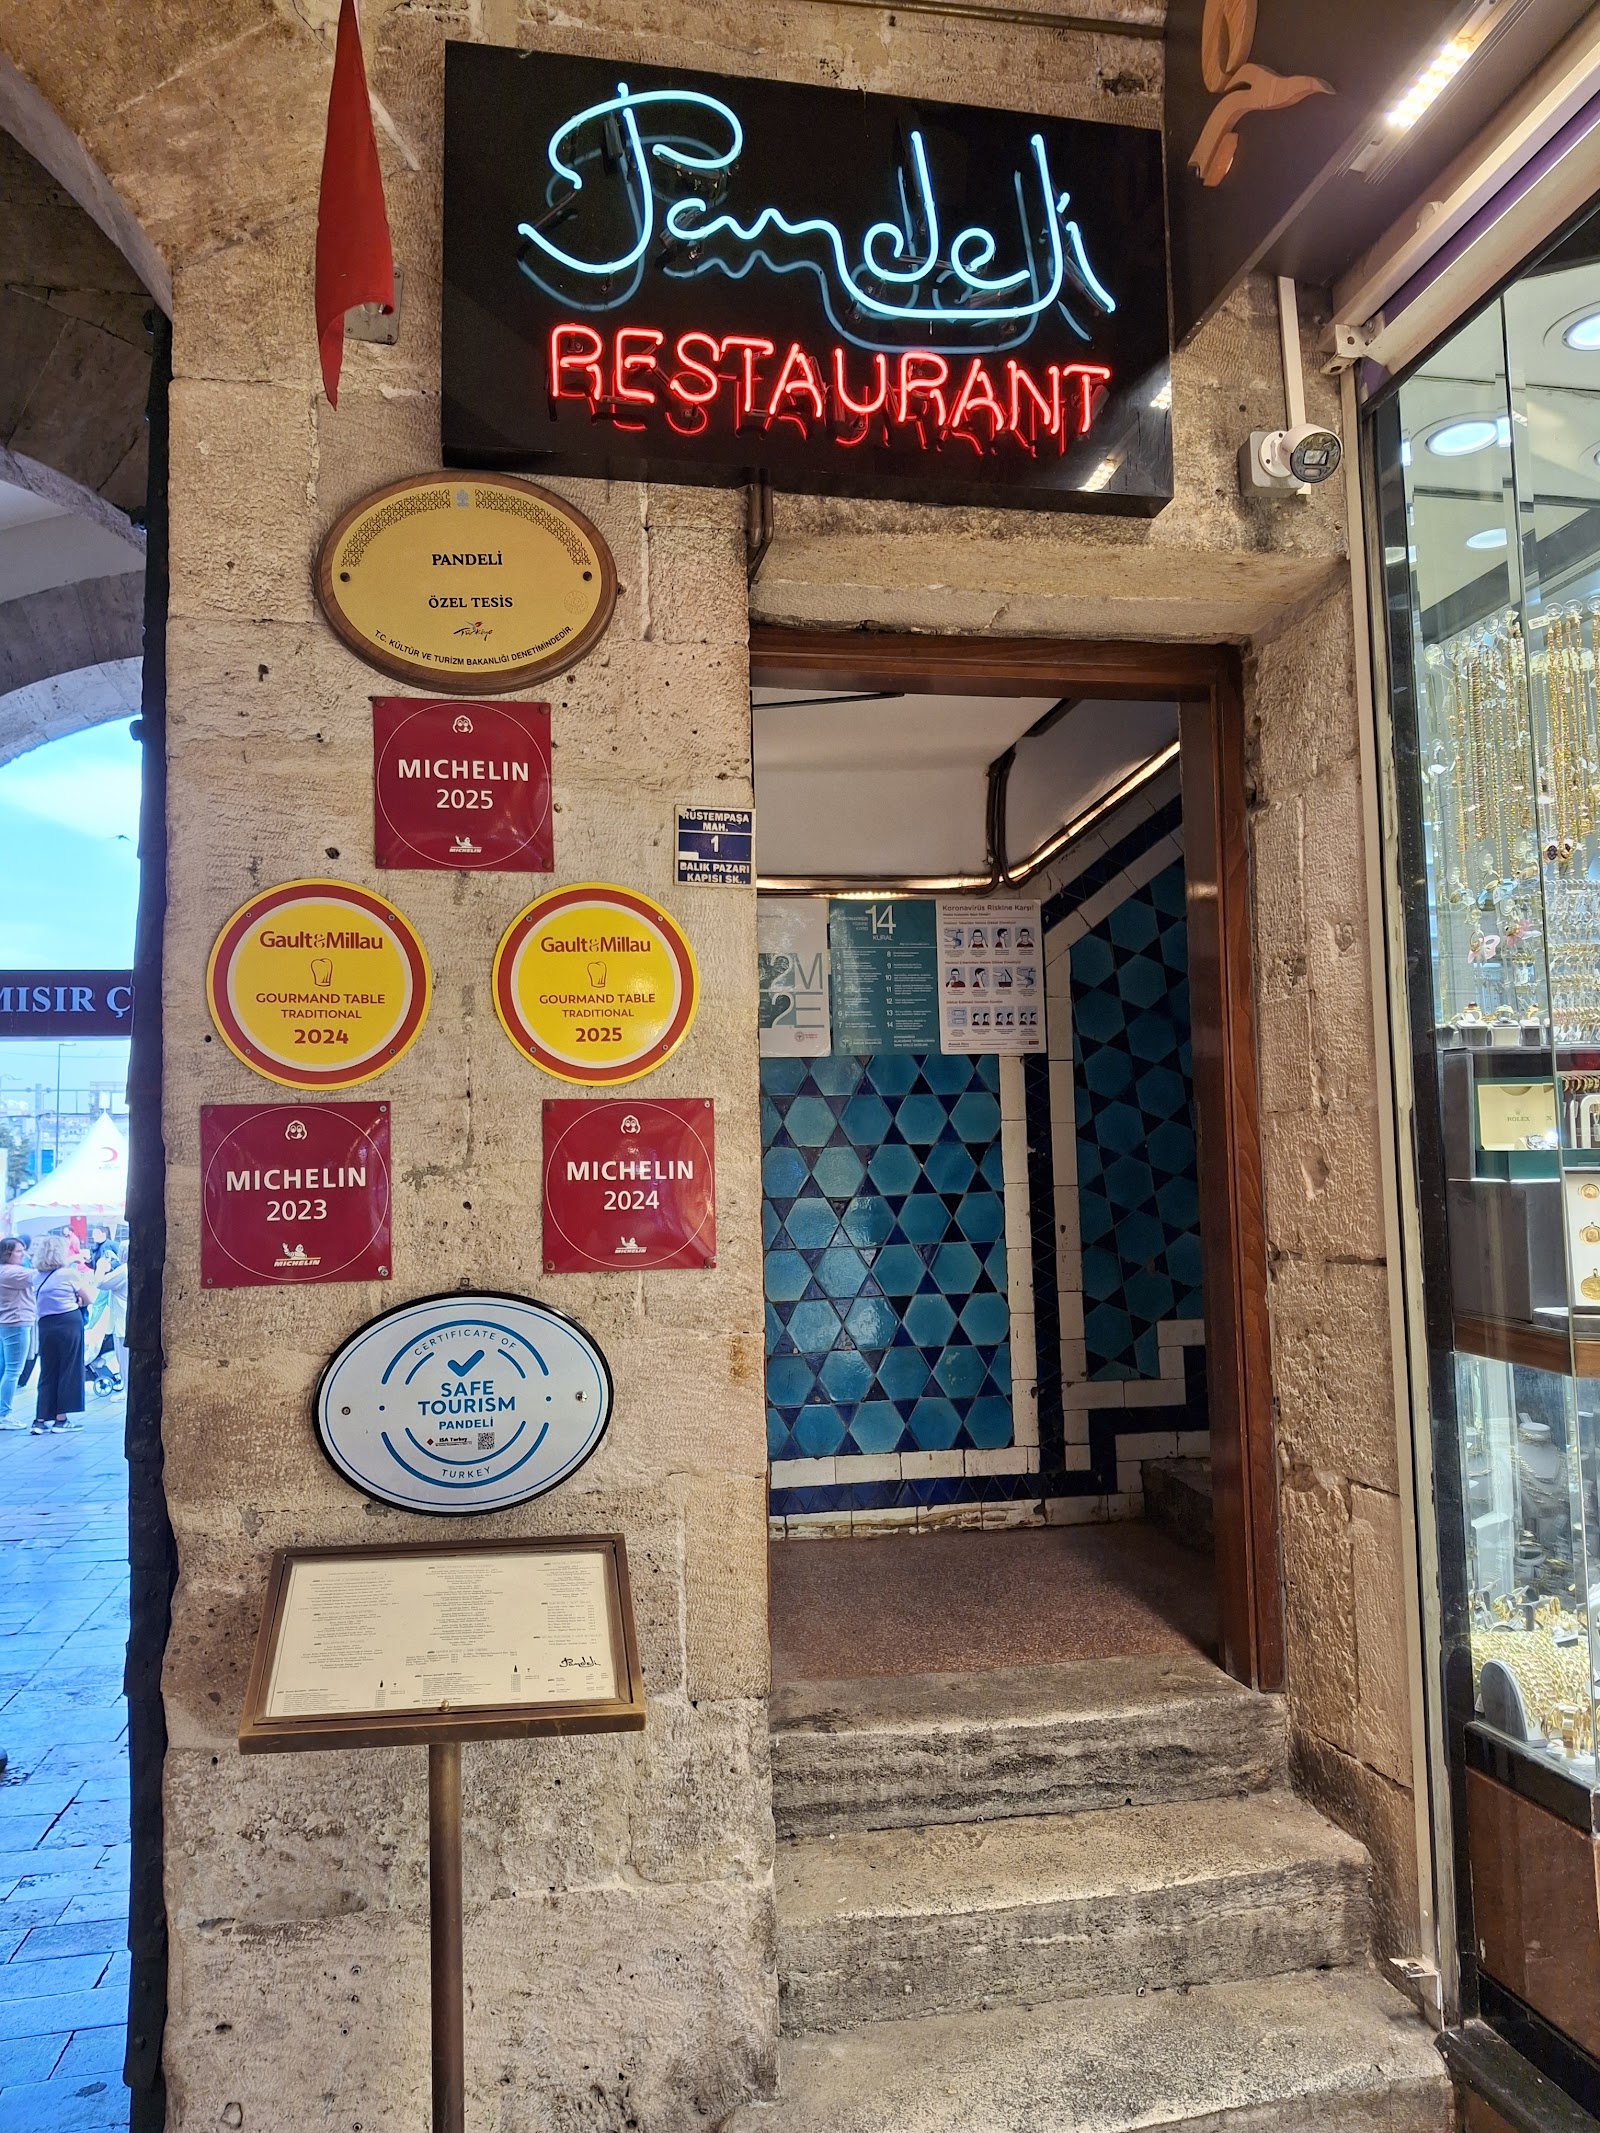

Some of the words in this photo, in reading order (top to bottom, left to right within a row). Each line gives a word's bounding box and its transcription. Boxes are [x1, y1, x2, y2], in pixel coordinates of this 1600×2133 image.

[519, 82, 1116, 319] Pandeli
[550, 323, 1111, 437] RESTAURANT
[432, 550, 503, 566] PANDELİ
[428, 595, 467, 608] ÖZEL
[470, 596, 513, 608] TESİS
[374, 629, 387, 643] T.C.
[388, 639, 420, 657] KÜLTÜR
[421, 651, 432, 661] VE
[434, 654, 464, 665] TURİZM
[466, 655, 510, 666] BAKANLIĞI
[398, 759, 529, 782] MICHELIN
[436, 789, 494, 810] 2025
[702, 822, 728, 832] MAH.
[710, 835, 719, 852] 1
[680, 862, 710, 872] BALIK
[713, 863, 749, 873] PAZARI
[687, 873, 722, 883] KAPISI
[942, 904, 985, 912] Koronavirüs
[865, 904, 897, 934] 14
[259, 931, 383, 950] Gault&Millau
[540, 936, 651, 954] Gault&Millau
[256, 993, 341, 1004] GOURMAND
[345, 993, 385, 1004] TABLE
[539, 993, 615, 1005] GOURMAND
[618, 992, 656, 1004] TABLE
[281, 1009, 362, 1019] TRADITIONAL
[562, 1009, 634, 1018] TRADITIONAL
[293, 1029, 349, 1045] 2024
[575, 1027, 622, 1043] 2025
[226, 1167, 366, 1191] MICHELIN
[567, 1160, 694, 1181] MICHELIN
[603, 1191, 660, 1211] 2024
[266, 1200, 328, 1222] 2023
[274, 1259, 320, 1267] MICHELIN
[414, 1329, 496, 1356] CERTIFICATE
[501, 1337, 516, 1350] OF
[441, 1380, 494, 1398] SAFE
[418, 1396, 516, 1416] TOURISM
[438, 1416, 493, 1430] PANDELİ
[441, 1466, 491, 1479] TURKEY
